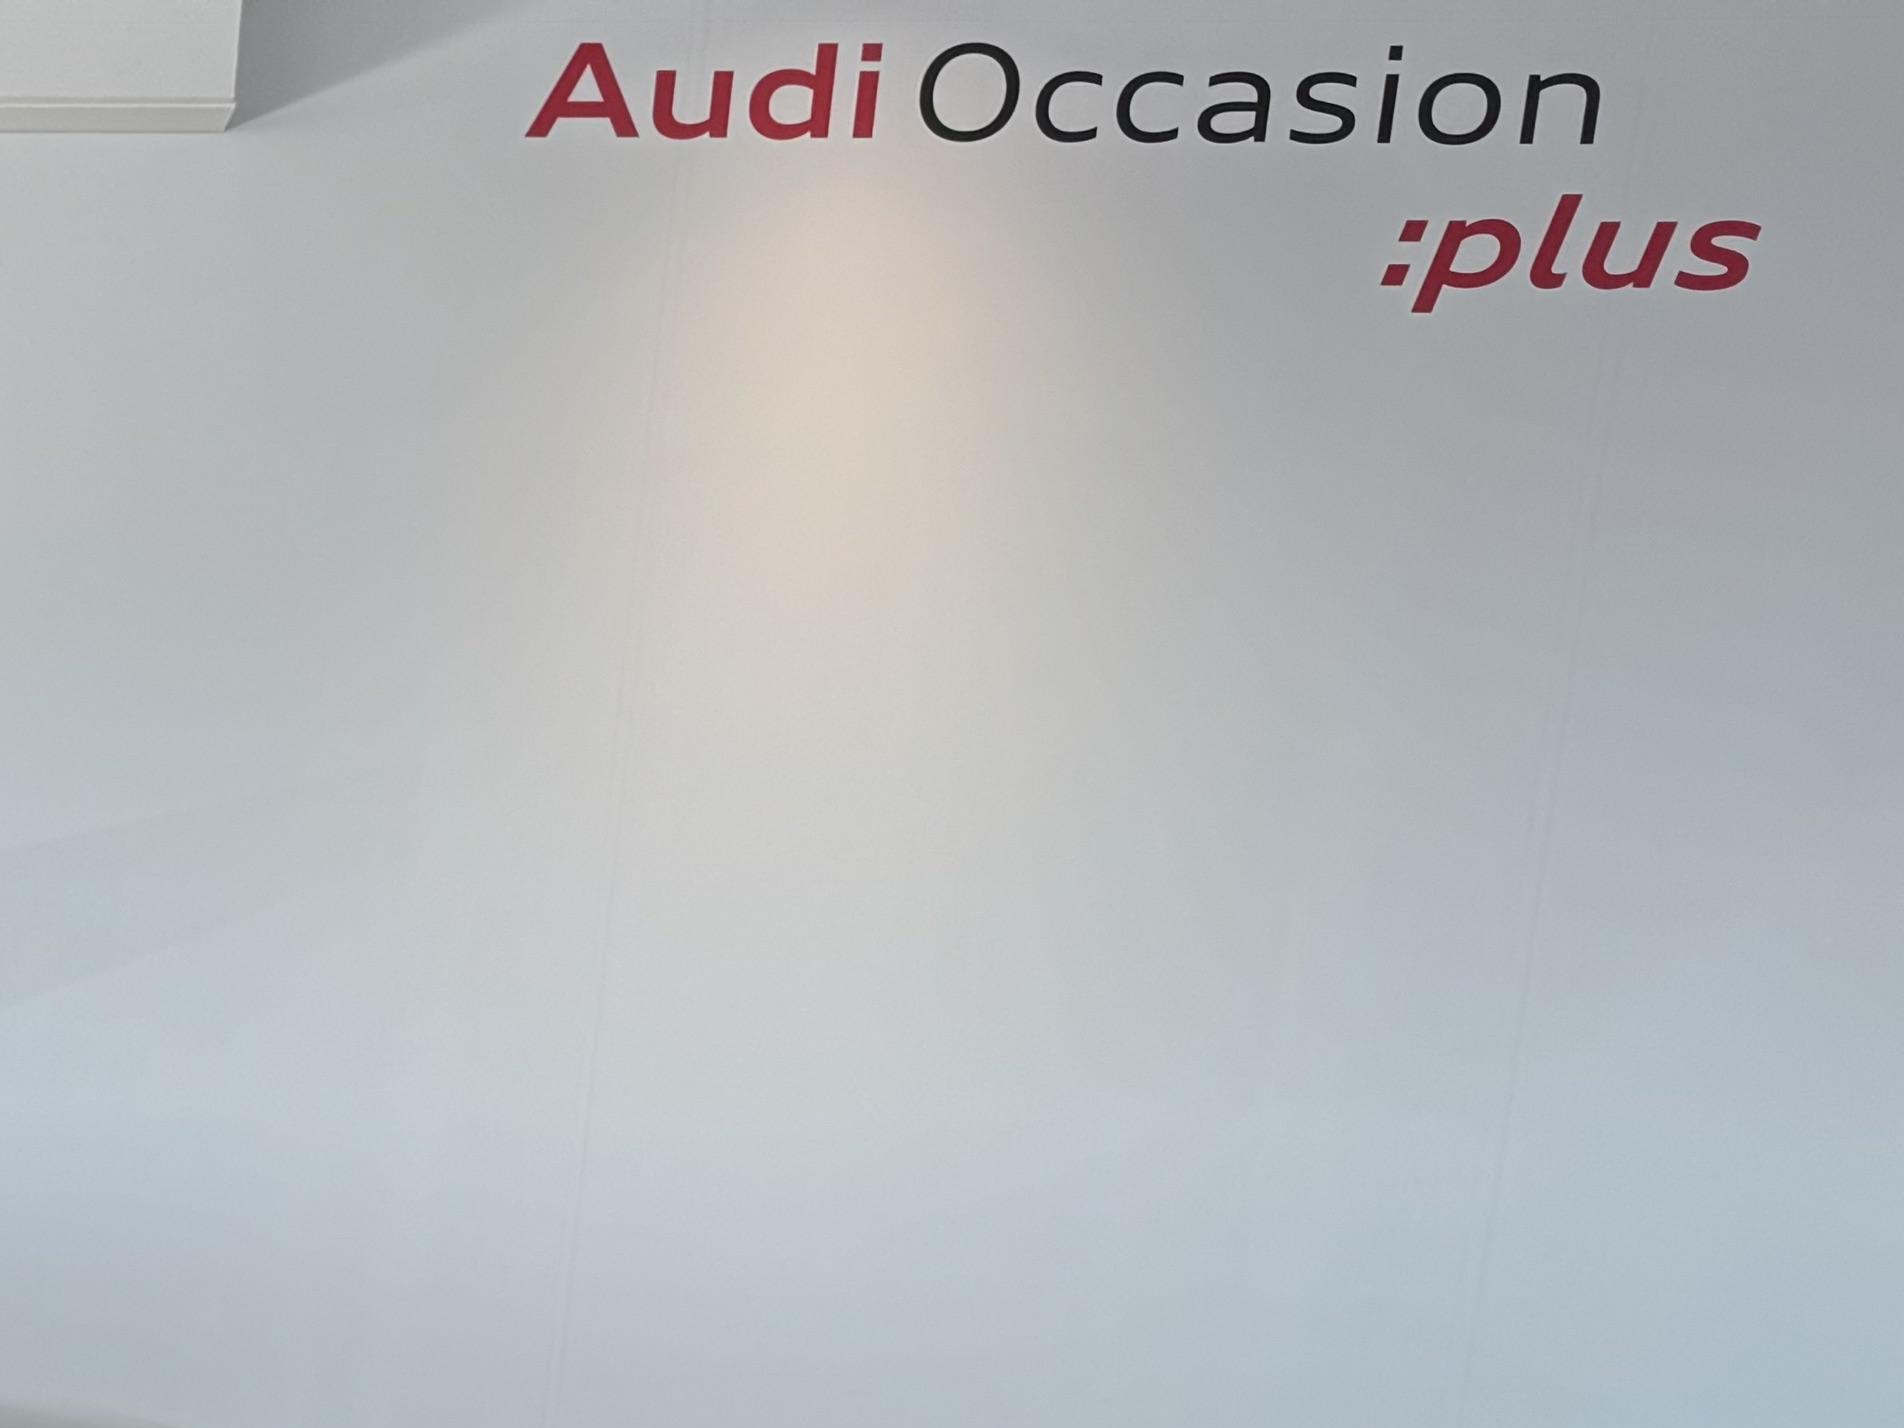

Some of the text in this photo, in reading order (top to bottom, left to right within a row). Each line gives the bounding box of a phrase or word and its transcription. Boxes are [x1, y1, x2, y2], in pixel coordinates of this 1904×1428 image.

[524, 42, 1604, 147] Audi Occasion
[1380, 194, 1762, 314] :plus
